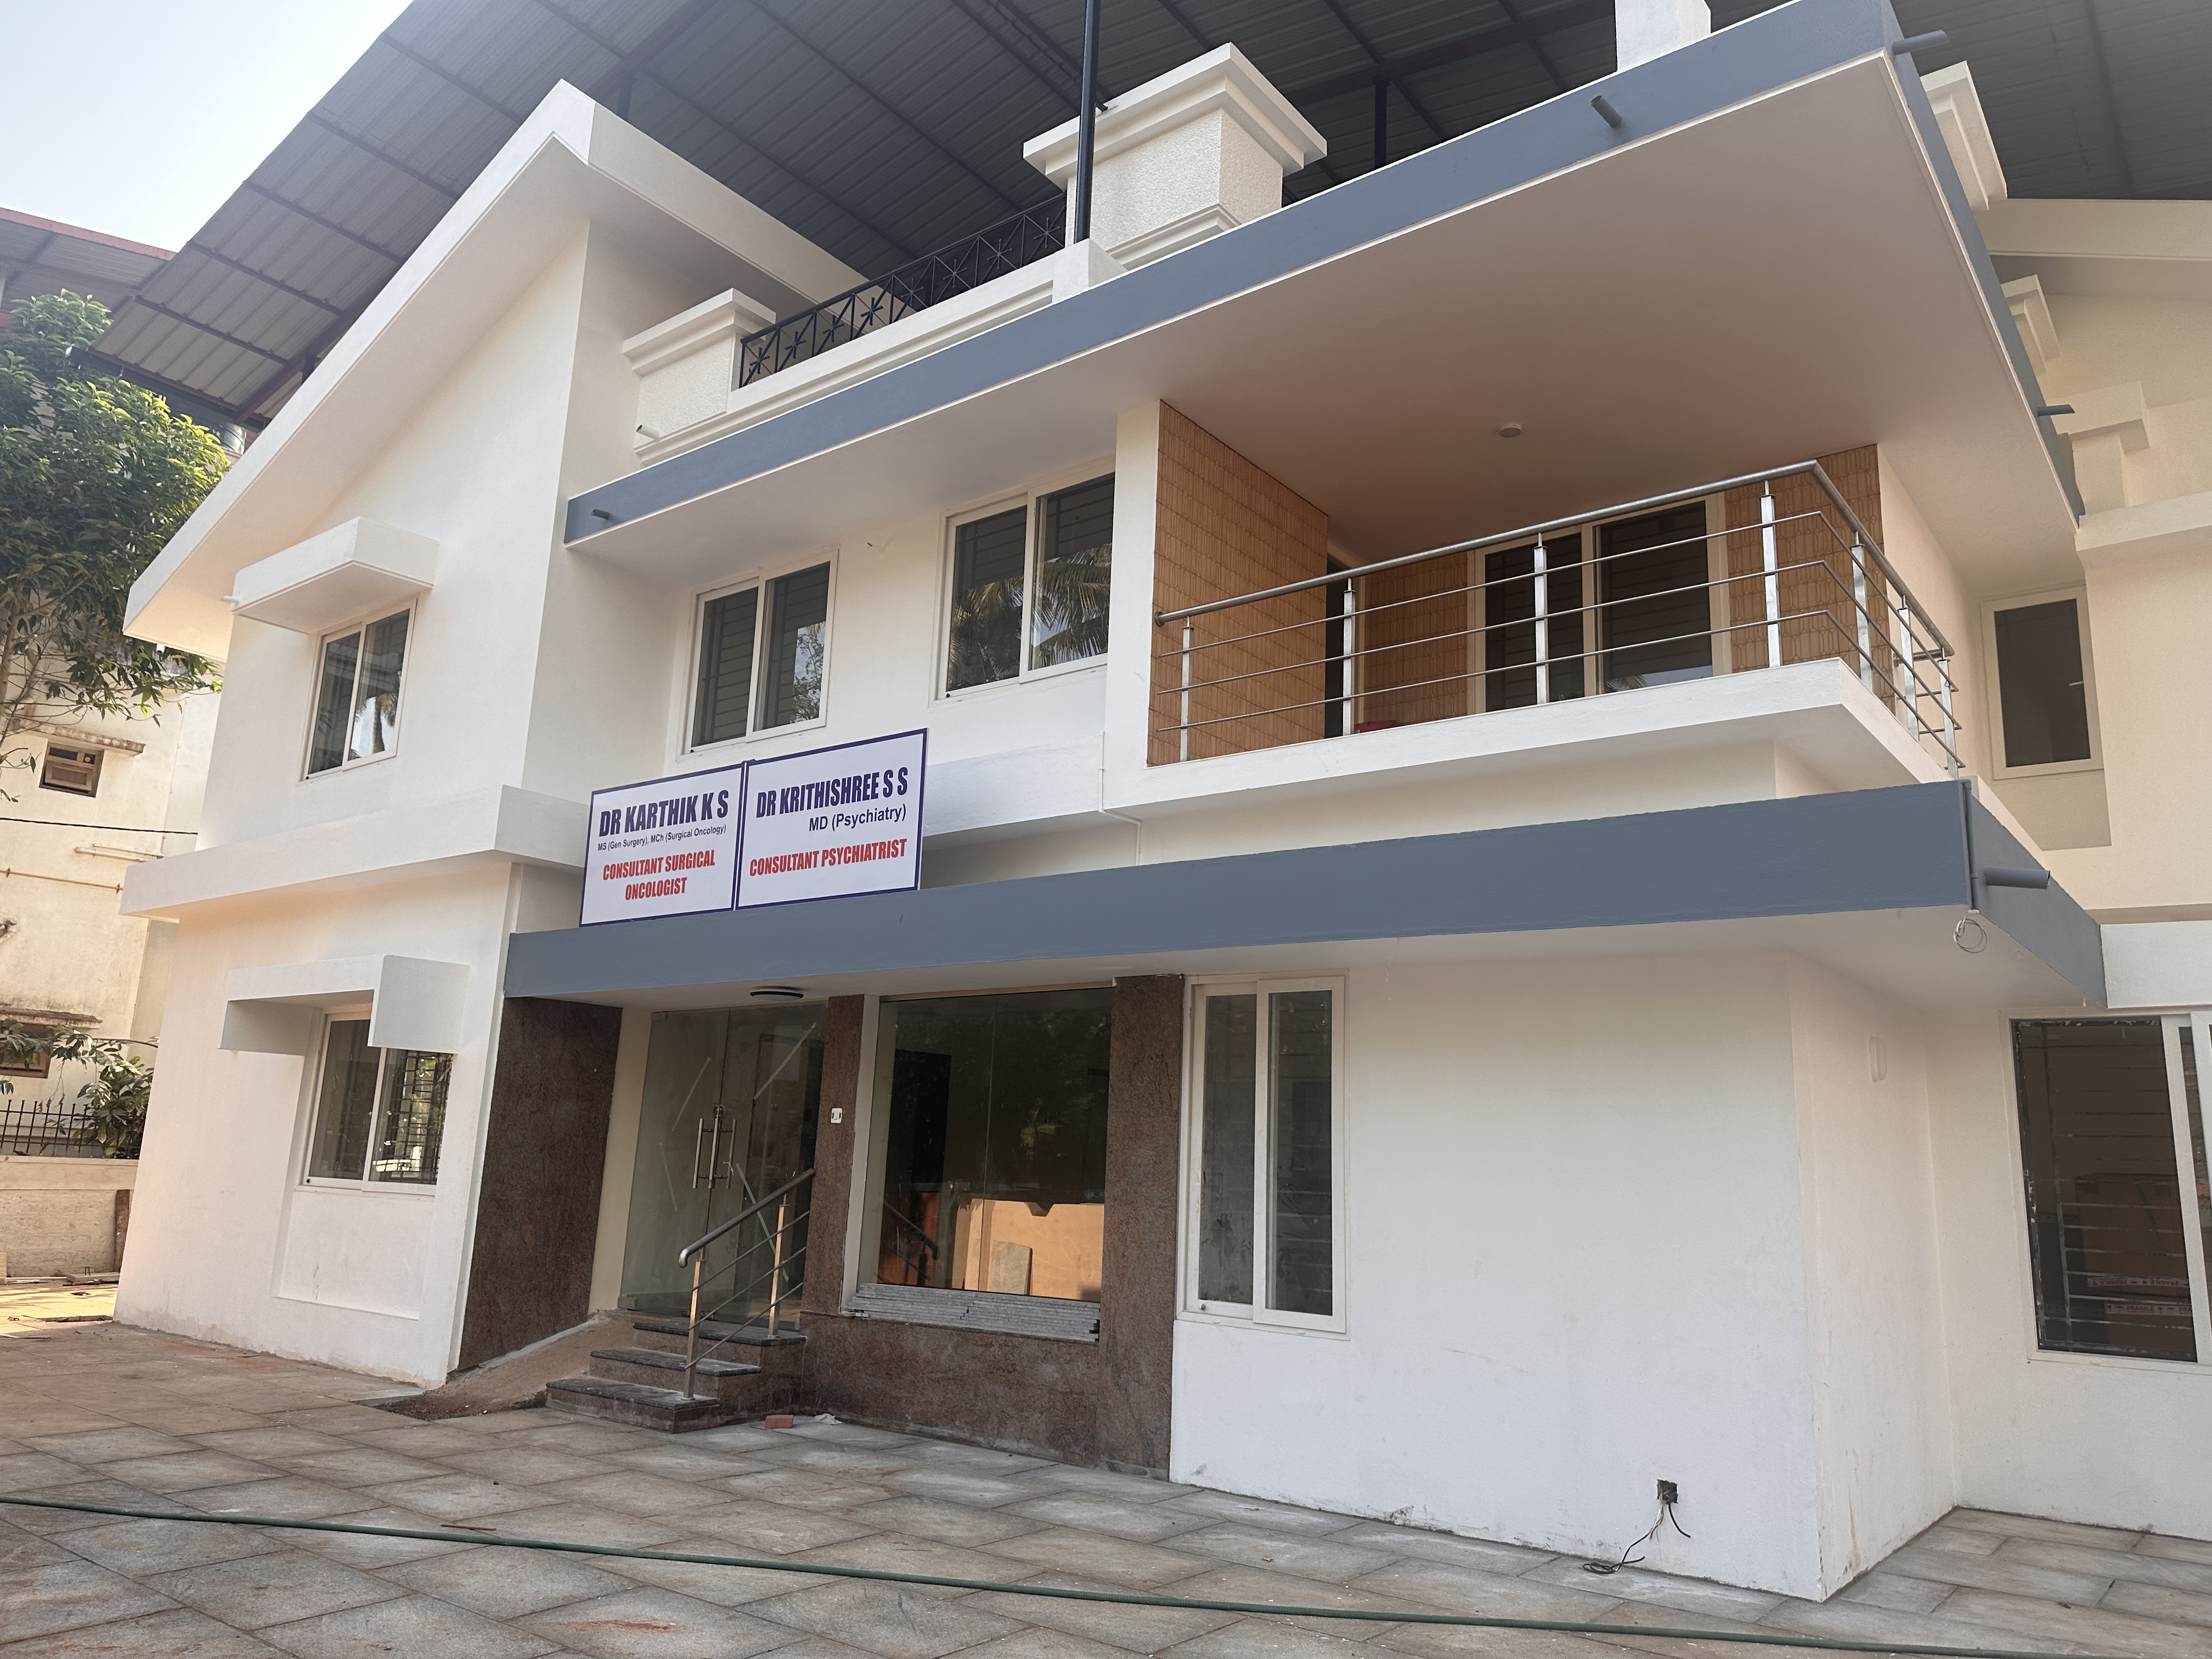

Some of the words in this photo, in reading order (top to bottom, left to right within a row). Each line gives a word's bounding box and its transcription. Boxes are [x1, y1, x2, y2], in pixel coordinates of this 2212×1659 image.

[756, 790, 776, 818] DR
[779, 771, 879, 815] KRITHISHREE
[883, 769, 894, 798] S
[898, 766, 908, 795] S
[599, 809, 622, 837] DR
[624, 795, 698, 833] KARTHIK
[701, 792, 714, 821] K
[717, 790, 729, 818] S
[809, 816, 828, 832] MD
[832, 803, 906, 832] (Psychiatry)
[598, 843, 607, 851] MS
[608, 841, 622, 851] (Gen
[623, 836, 649, 849] Surgery),
[651, 834, 664, 843] MCh
[665, 829, 692, 843] (Surgical
[694, 824, 726, 837] Oncology)
[603, 857, 663, 881] CONSULTANT
[665, 850, 715, 872] SURGICAL
[749, 850, 820, 877] CONSULTANT
[821, 838, 907, 867] PSYCHIATRIST
[625, 877, 687, 900] ONCOLOGIST
